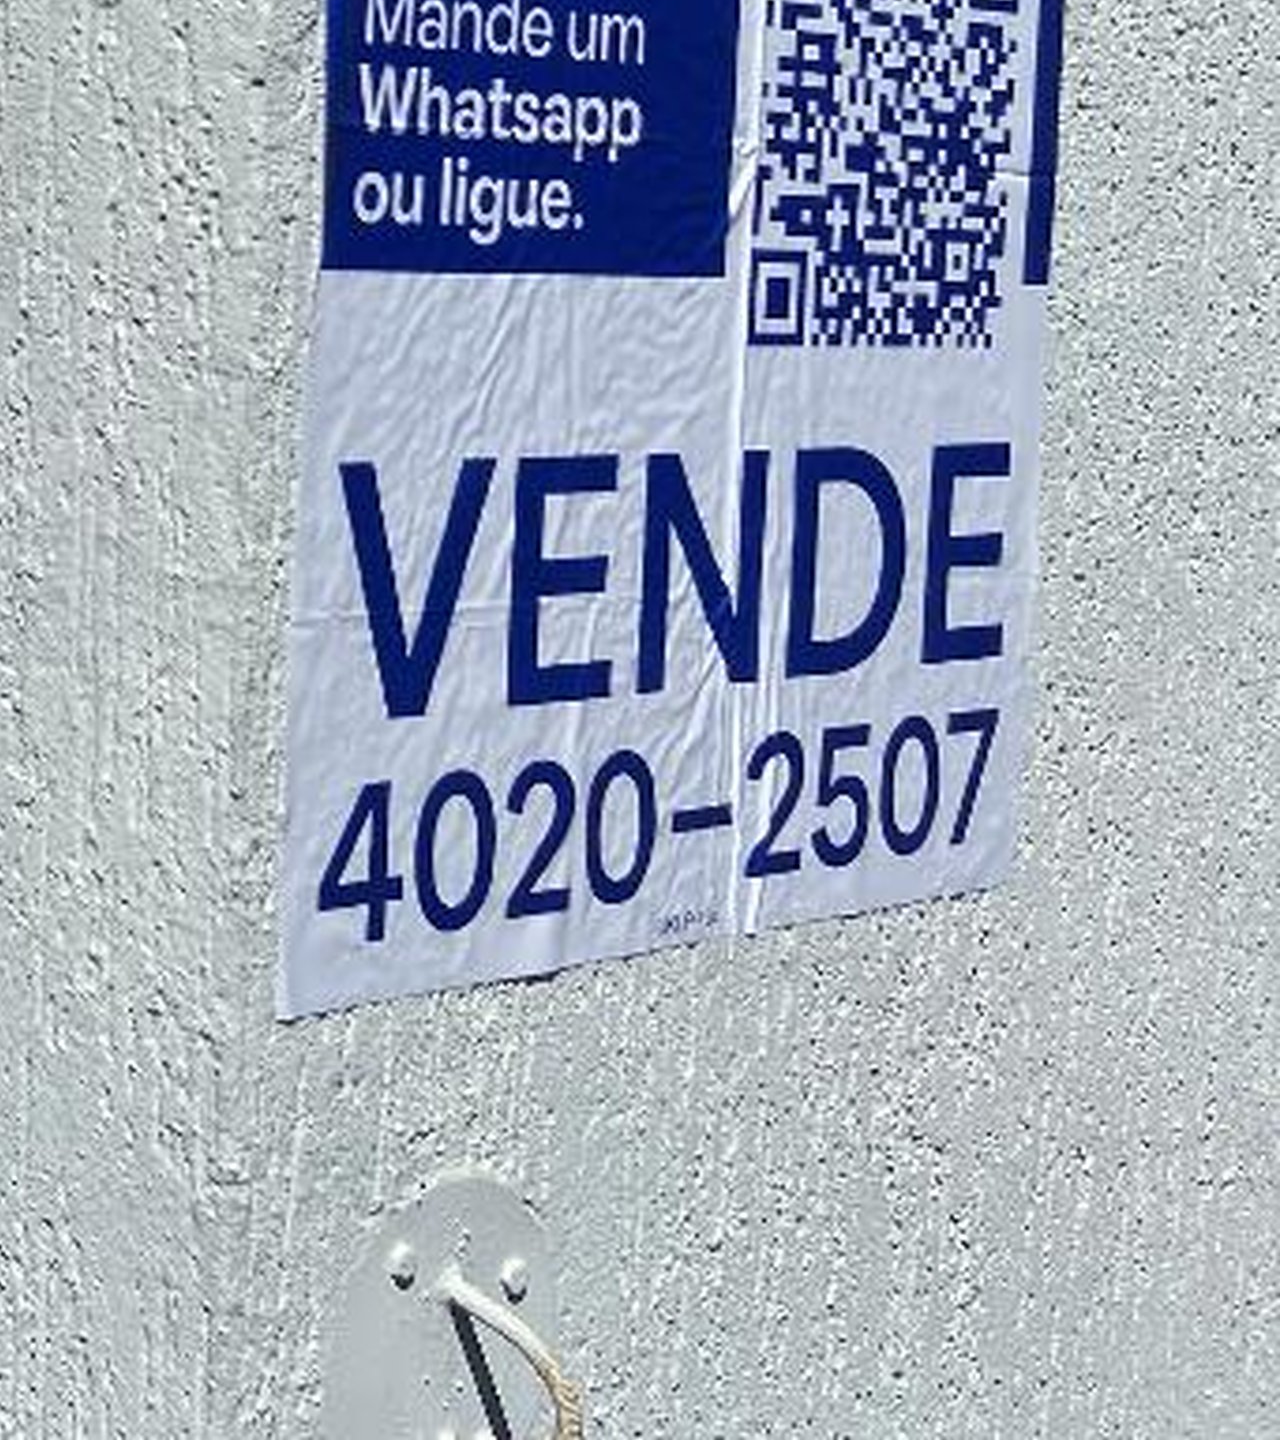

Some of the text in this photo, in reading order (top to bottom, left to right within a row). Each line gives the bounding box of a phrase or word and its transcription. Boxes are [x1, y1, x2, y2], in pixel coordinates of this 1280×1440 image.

[567, 11, 646, 65] um
[358, 62, 644, 163] Whatsapp
[352, 156, 585, 246] ou ligue.
[338, 441, 1012, 720] VENDE
[316, 708, 1000, 942] 4020-2507
